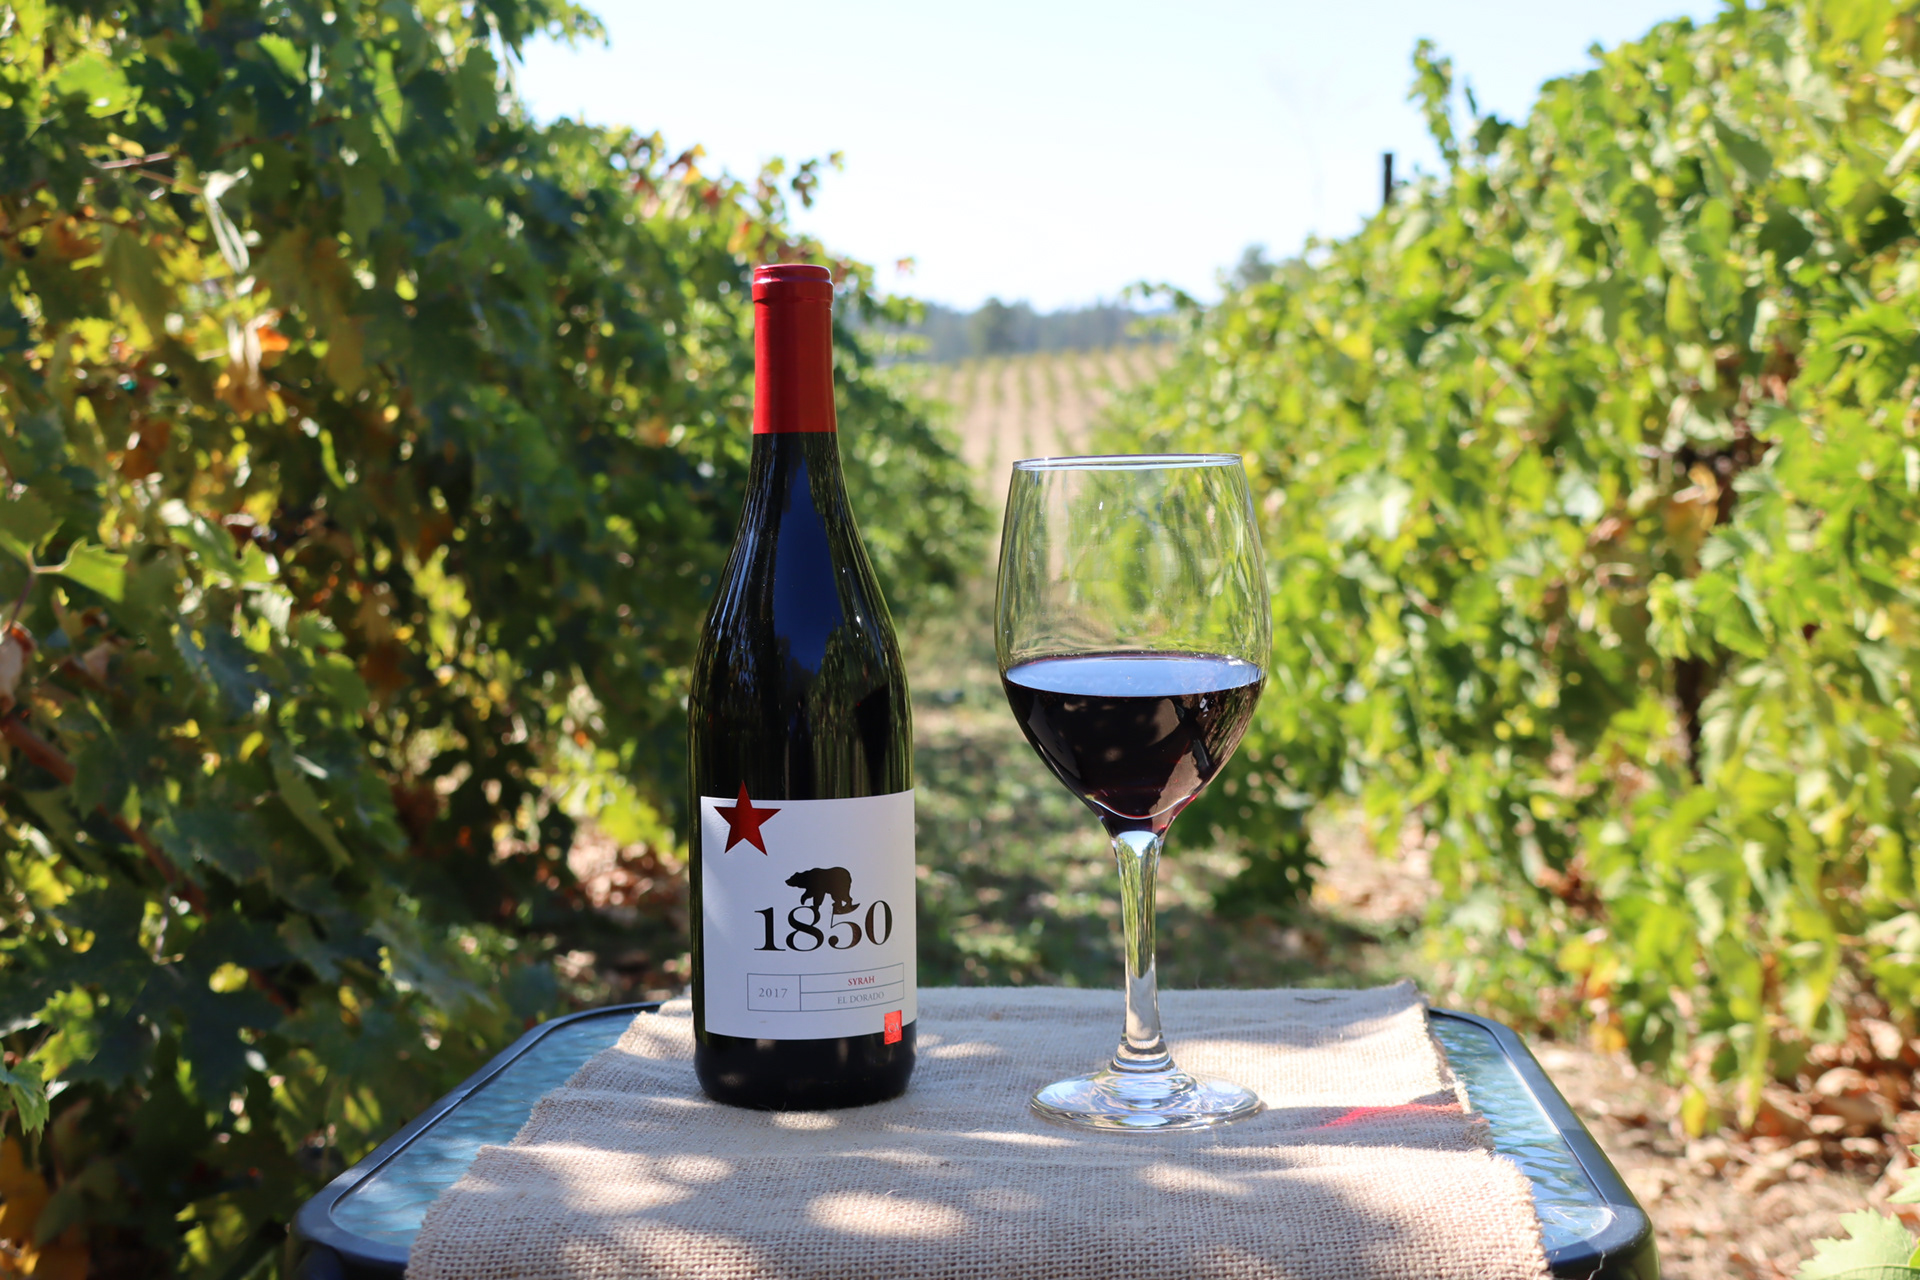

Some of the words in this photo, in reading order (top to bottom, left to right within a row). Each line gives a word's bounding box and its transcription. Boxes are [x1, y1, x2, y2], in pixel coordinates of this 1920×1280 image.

[754, 900, 892, 951] 1850
[848, 976, 875, 986] SYRAH
[758, 988, 788, 998] 2017
[837, 996, 848, 1005] EL
[850, 991, 885, 1003] DORADO
